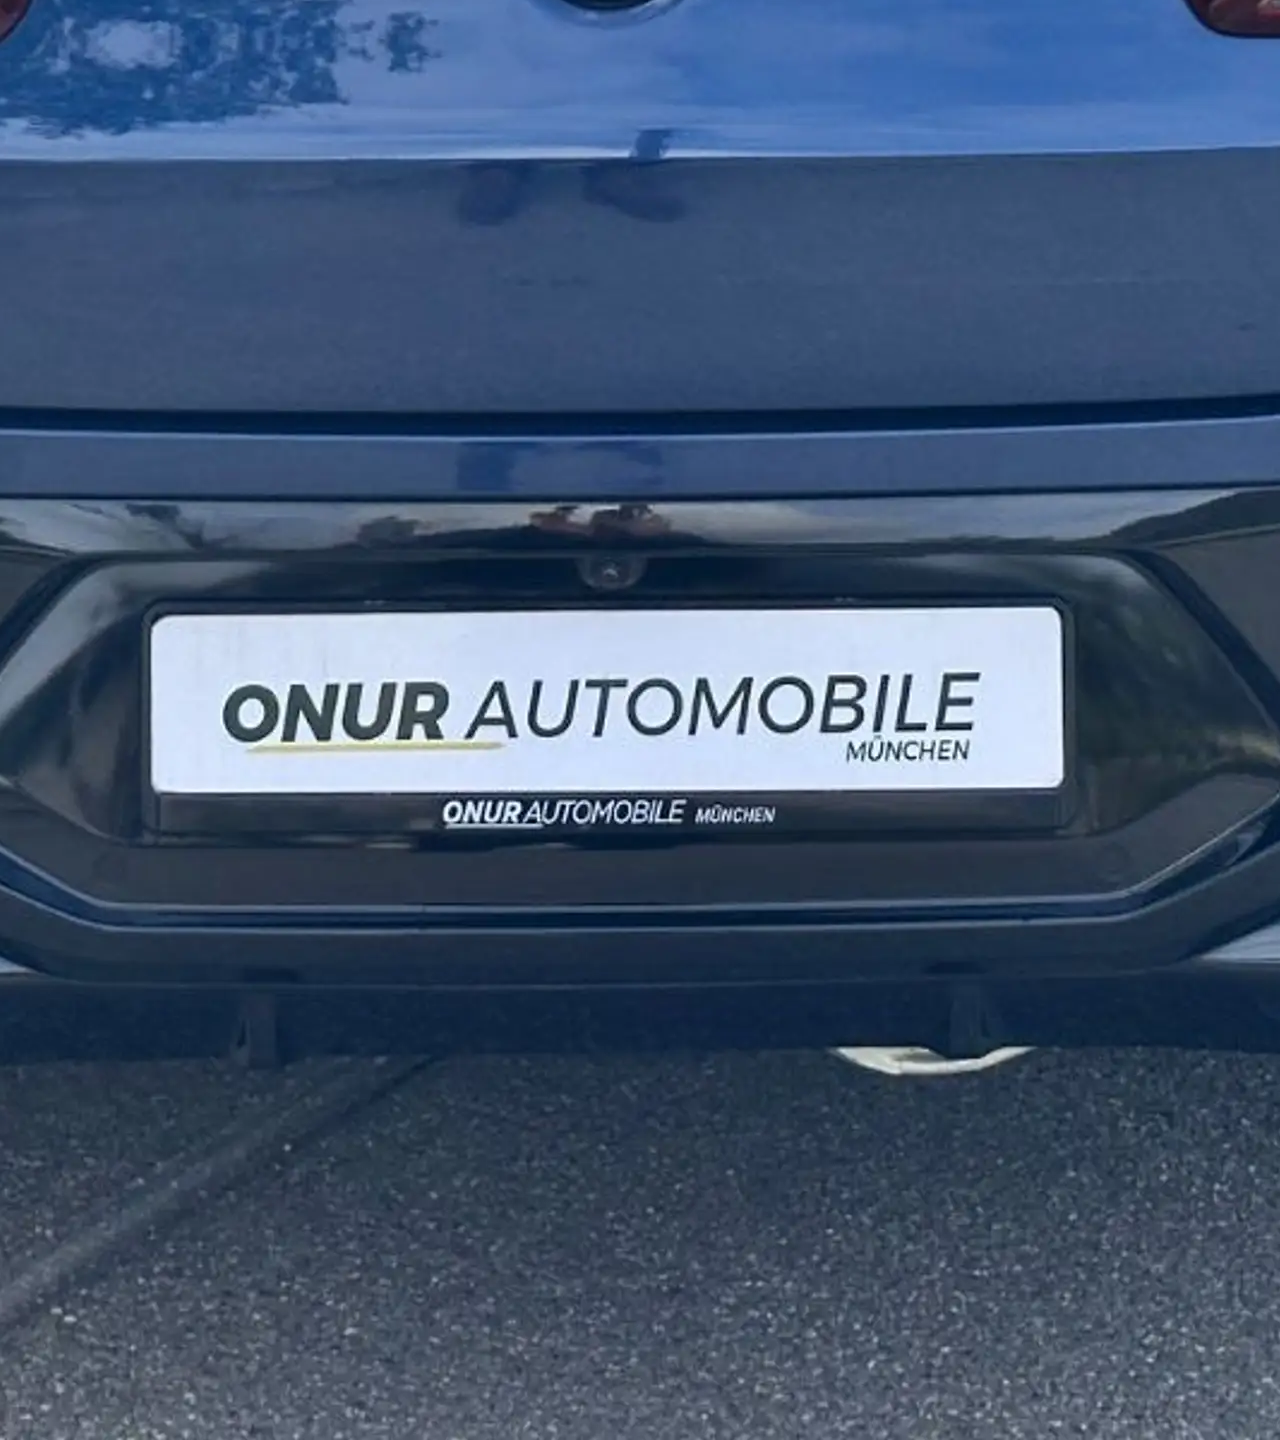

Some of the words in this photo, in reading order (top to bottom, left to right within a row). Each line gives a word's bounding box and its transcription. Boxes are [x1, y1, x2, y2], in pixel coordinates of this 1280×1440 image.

[223, 682, 450, 743] ONUR
[464, 672, 981, 740] AUTOMOBILE
[845, 735, 971, 763] MÜNCHEN
[442, 800, 521, 825] ONUR
[521, 798, 687, 825] AUTOMOBILE
[694, 806, 776, 824] MÜNCHEN
